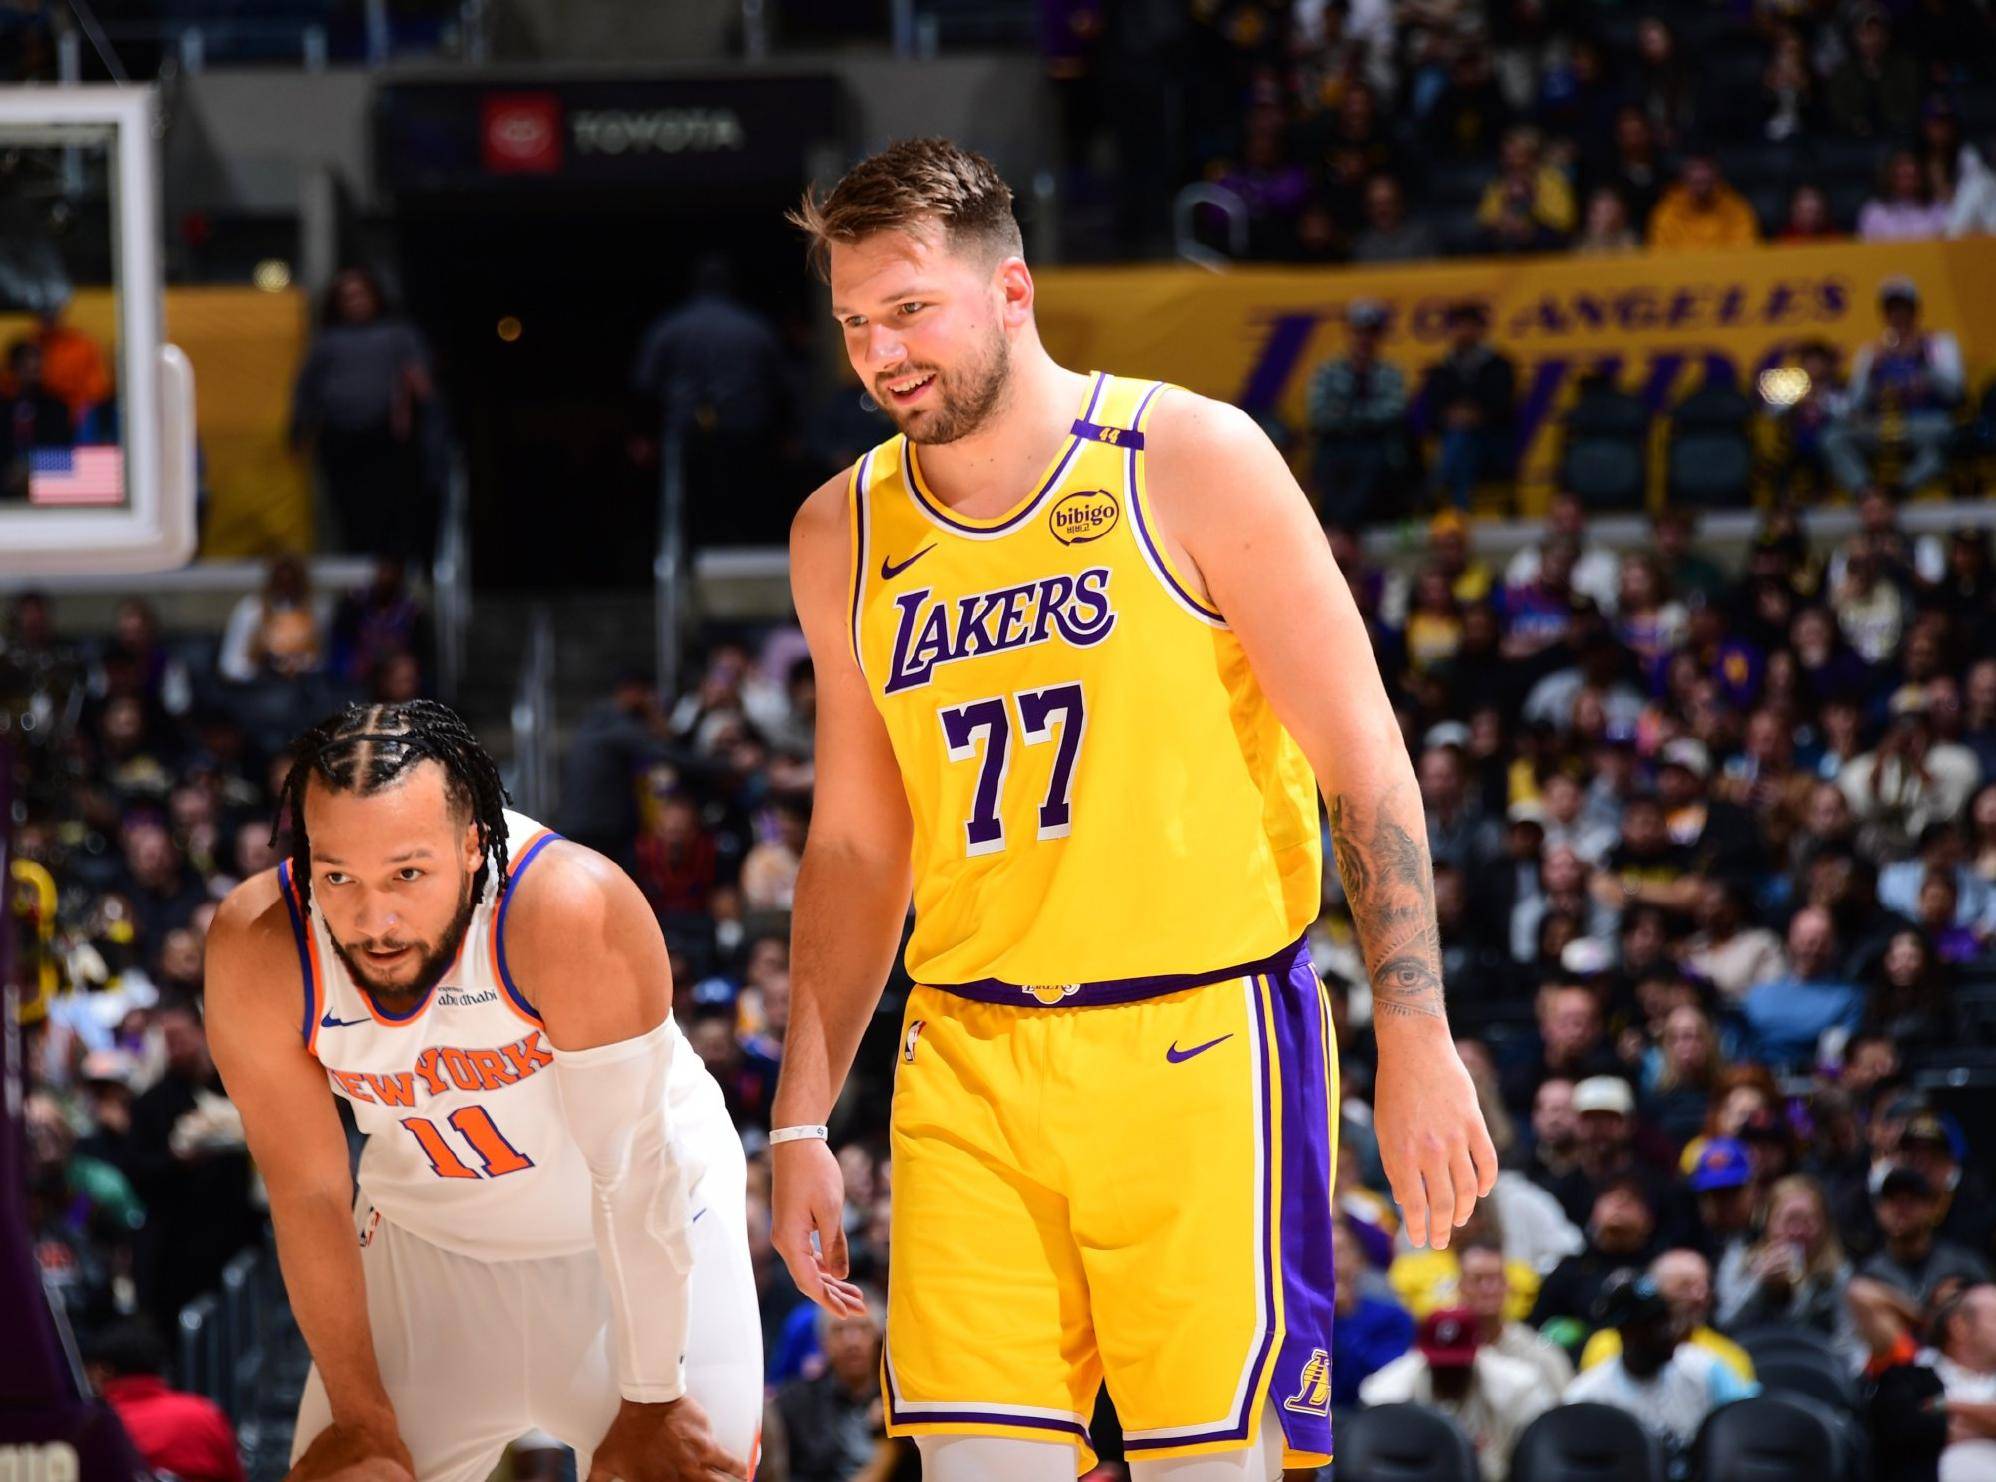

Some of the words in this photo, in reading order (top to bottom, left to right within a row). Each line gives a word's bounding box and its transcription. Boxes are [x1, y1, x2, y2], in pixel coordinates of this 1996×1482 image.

[571, 109, 744, 153] TOYOTA
[1508, 277, 1851, 338] ANGELES
[1099, 427, 1120, 444] 44
[1056, 505, 1115, 527] bibigo
[884, 566, 1118, 695] LAKERS
[937, 680, 1088, 858] 77
[459, 988, 498, 1006] dhabi
[328, 1067, 416, 1107] EW
[415, 1030, 554, 1097] YORK
[399, 1105, 535, 1179] 11
